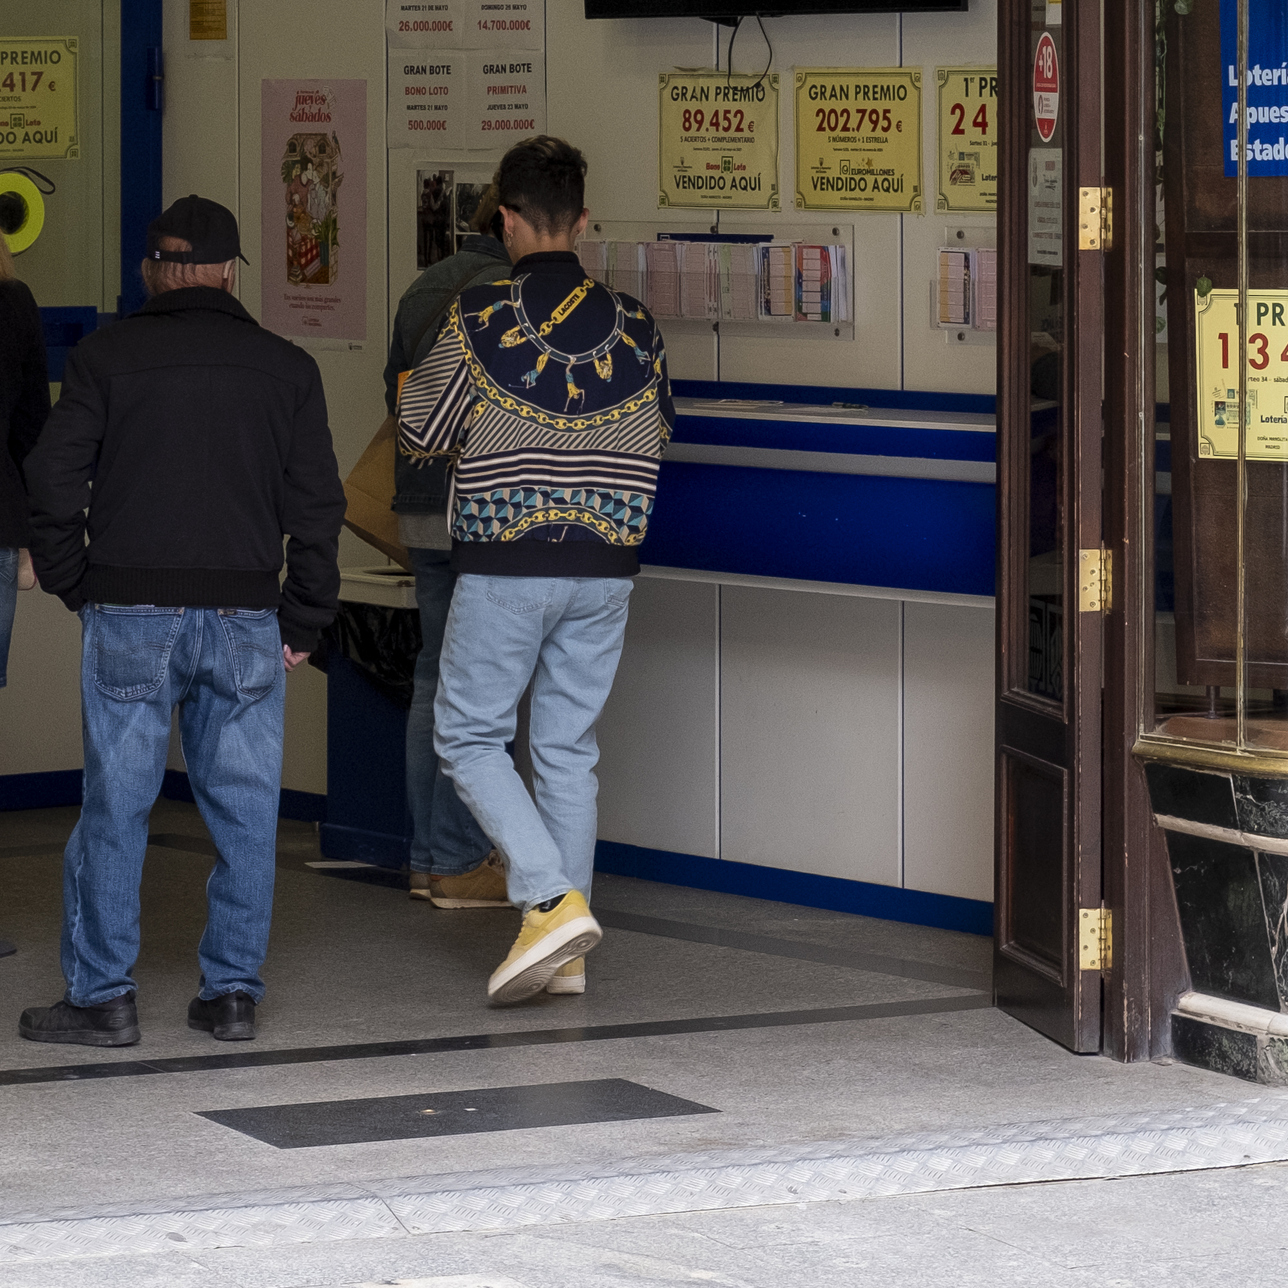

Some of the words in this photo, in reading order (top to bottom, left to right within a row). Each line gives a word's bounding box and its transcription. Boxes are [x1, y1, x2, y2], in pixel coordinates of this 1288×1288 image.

[398, 20, 453, 31] 26.000.000€
[477, 20, 531, 31] 14.700.000€
[0, 50, 62, 65] PREMIO
[1038, 45, 1053, 79] +18
[403, 65, 427, 75] GRAN
[429, 65, 451, 75] BOTE
[482, 64, 507, 75] GRAN
[509, 63, 532, 73] BOTE
[48, 80, 56, 92] €
[405, 86, 426, 96] BONO
[429, 86, 449, 95] LOTO
[487, 85, 527, 95] PRIMITIVA
[671, 86, 710, 102] GRAN
[715, 86, 765, 102] PREMIO
[808, 84, 849, 101] GRAN
[854, 84, 907, 101] PREMIO
[407, 120, 447, 131] 500.000€
[481, 119, 535, 131] 29.000.000€
[682, 109, 745, 133] 89.452
[748, 121, 755, 133] €
[815, 108, 892, 133] 202.795
[896, 120, 902, 133] €
[22, 126, 58, 144] AQUÍ
[851, 168, 895, 176] EUROMILLONES
[674, 174, 726, 190] VENDIDO
[730, 172, 761, 192] AQUÍ
[812, 176, 867, 192] VENDIDO
[872, 174, 904, 193] AQUÍ
[1260, 413, 1288, 425] Lotería
